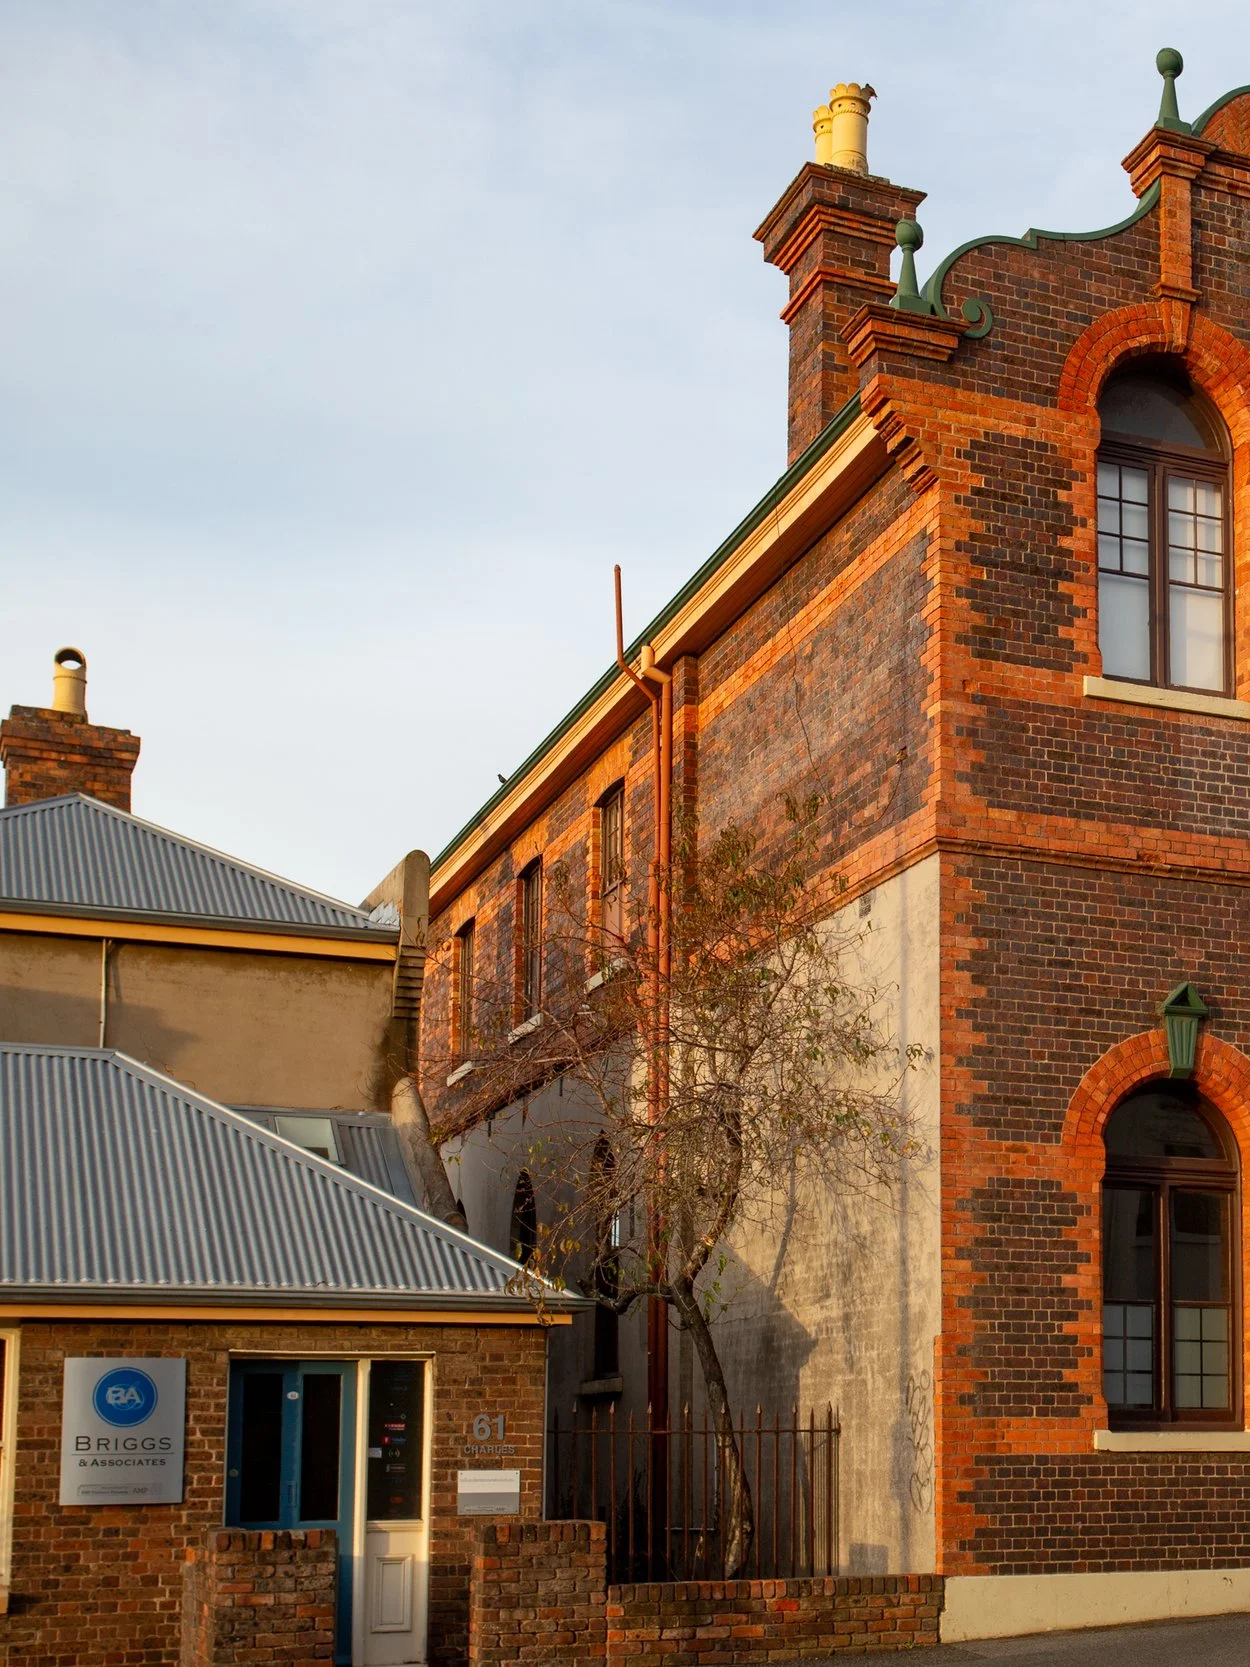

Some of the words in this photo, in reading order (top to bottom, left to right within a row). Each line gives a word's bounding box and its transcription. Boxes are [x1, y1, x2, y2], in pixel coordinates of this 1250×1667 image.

[472, 1413, 505, 1440] 61
[75, 1436, 172, 1451] BRIGGS
[463, 1444, 515, 1455] CHARLES
[78, 1458, 88, 1467] &
[90, 1458, 167, 1467] ASSOCIATES
